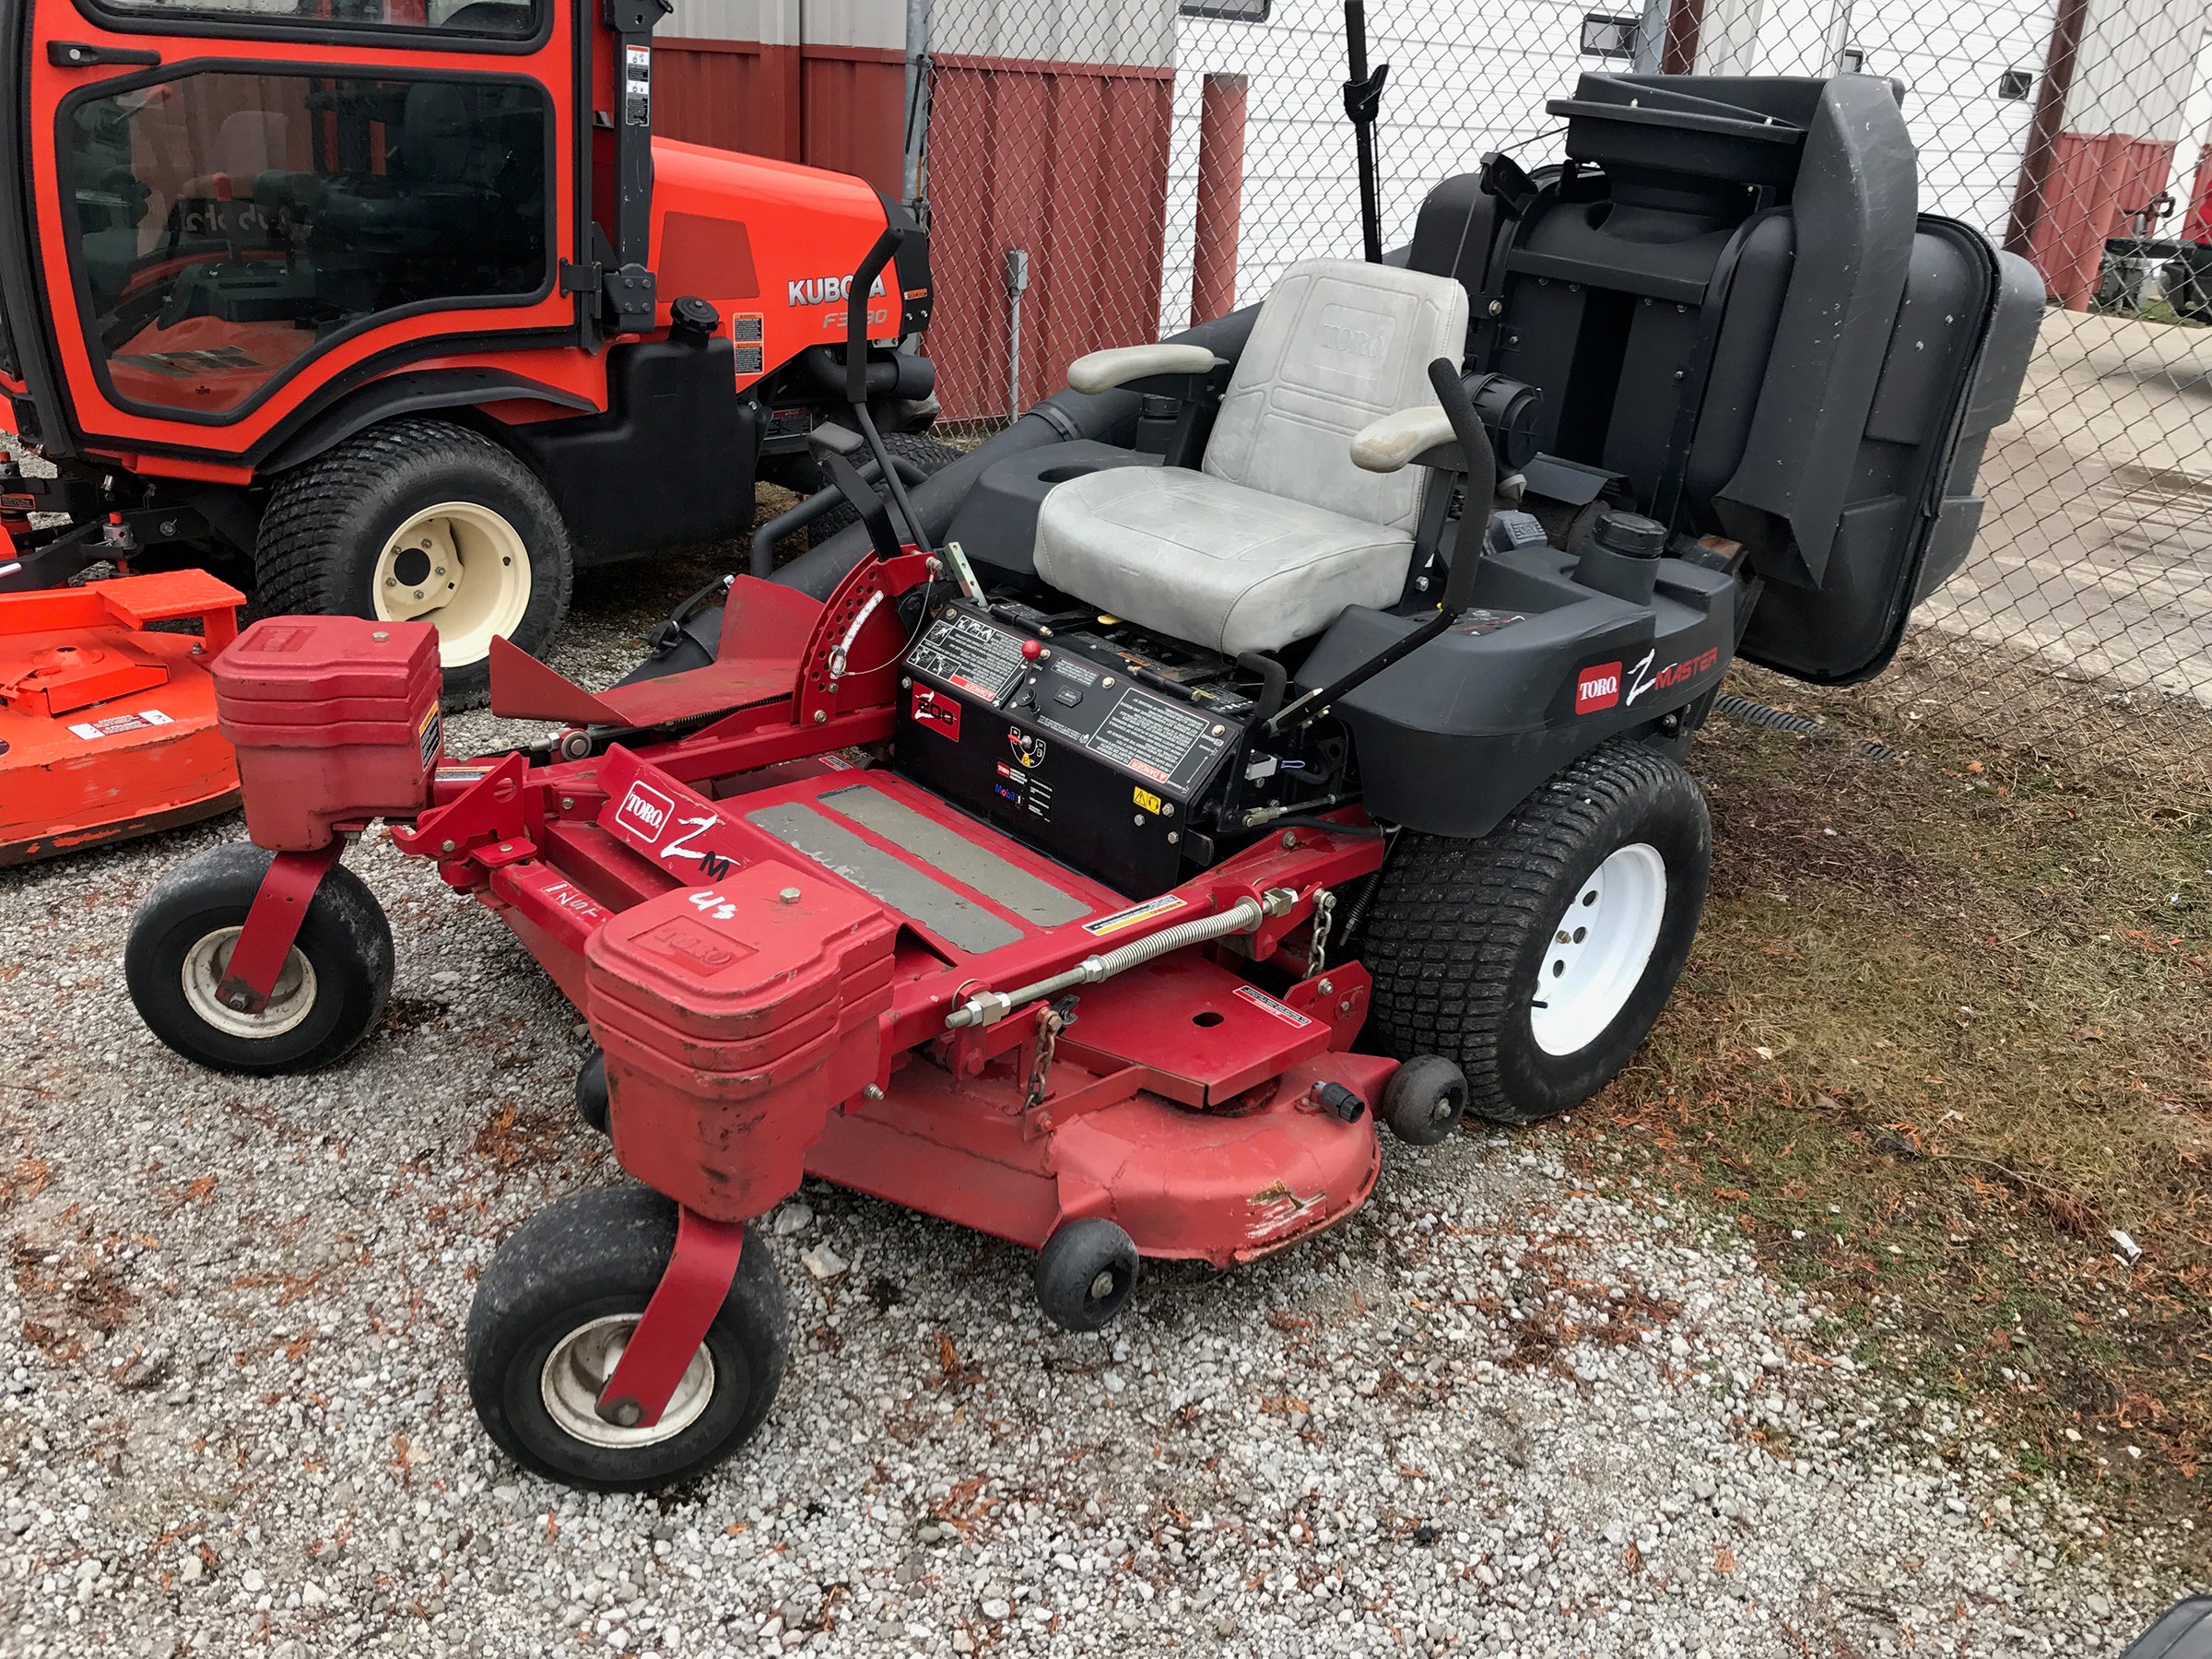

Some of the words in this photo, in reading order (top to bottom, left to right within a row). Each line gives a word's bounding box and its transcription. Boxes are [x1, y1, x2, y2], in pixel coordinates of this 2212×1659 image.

[788, 275, 886, 307] KUBOA
[822, 310, 888, 329] F390
[1580, 676, 1617, 700] TORO
[1654, 647, 1718, 690] MASTER
[1131, 760, 1159, 778] DANGER
[995, 783, 1015, 801] Mobil
[626, 794, 663, 829] TORO
[653, 926, 734, 965] TORO
